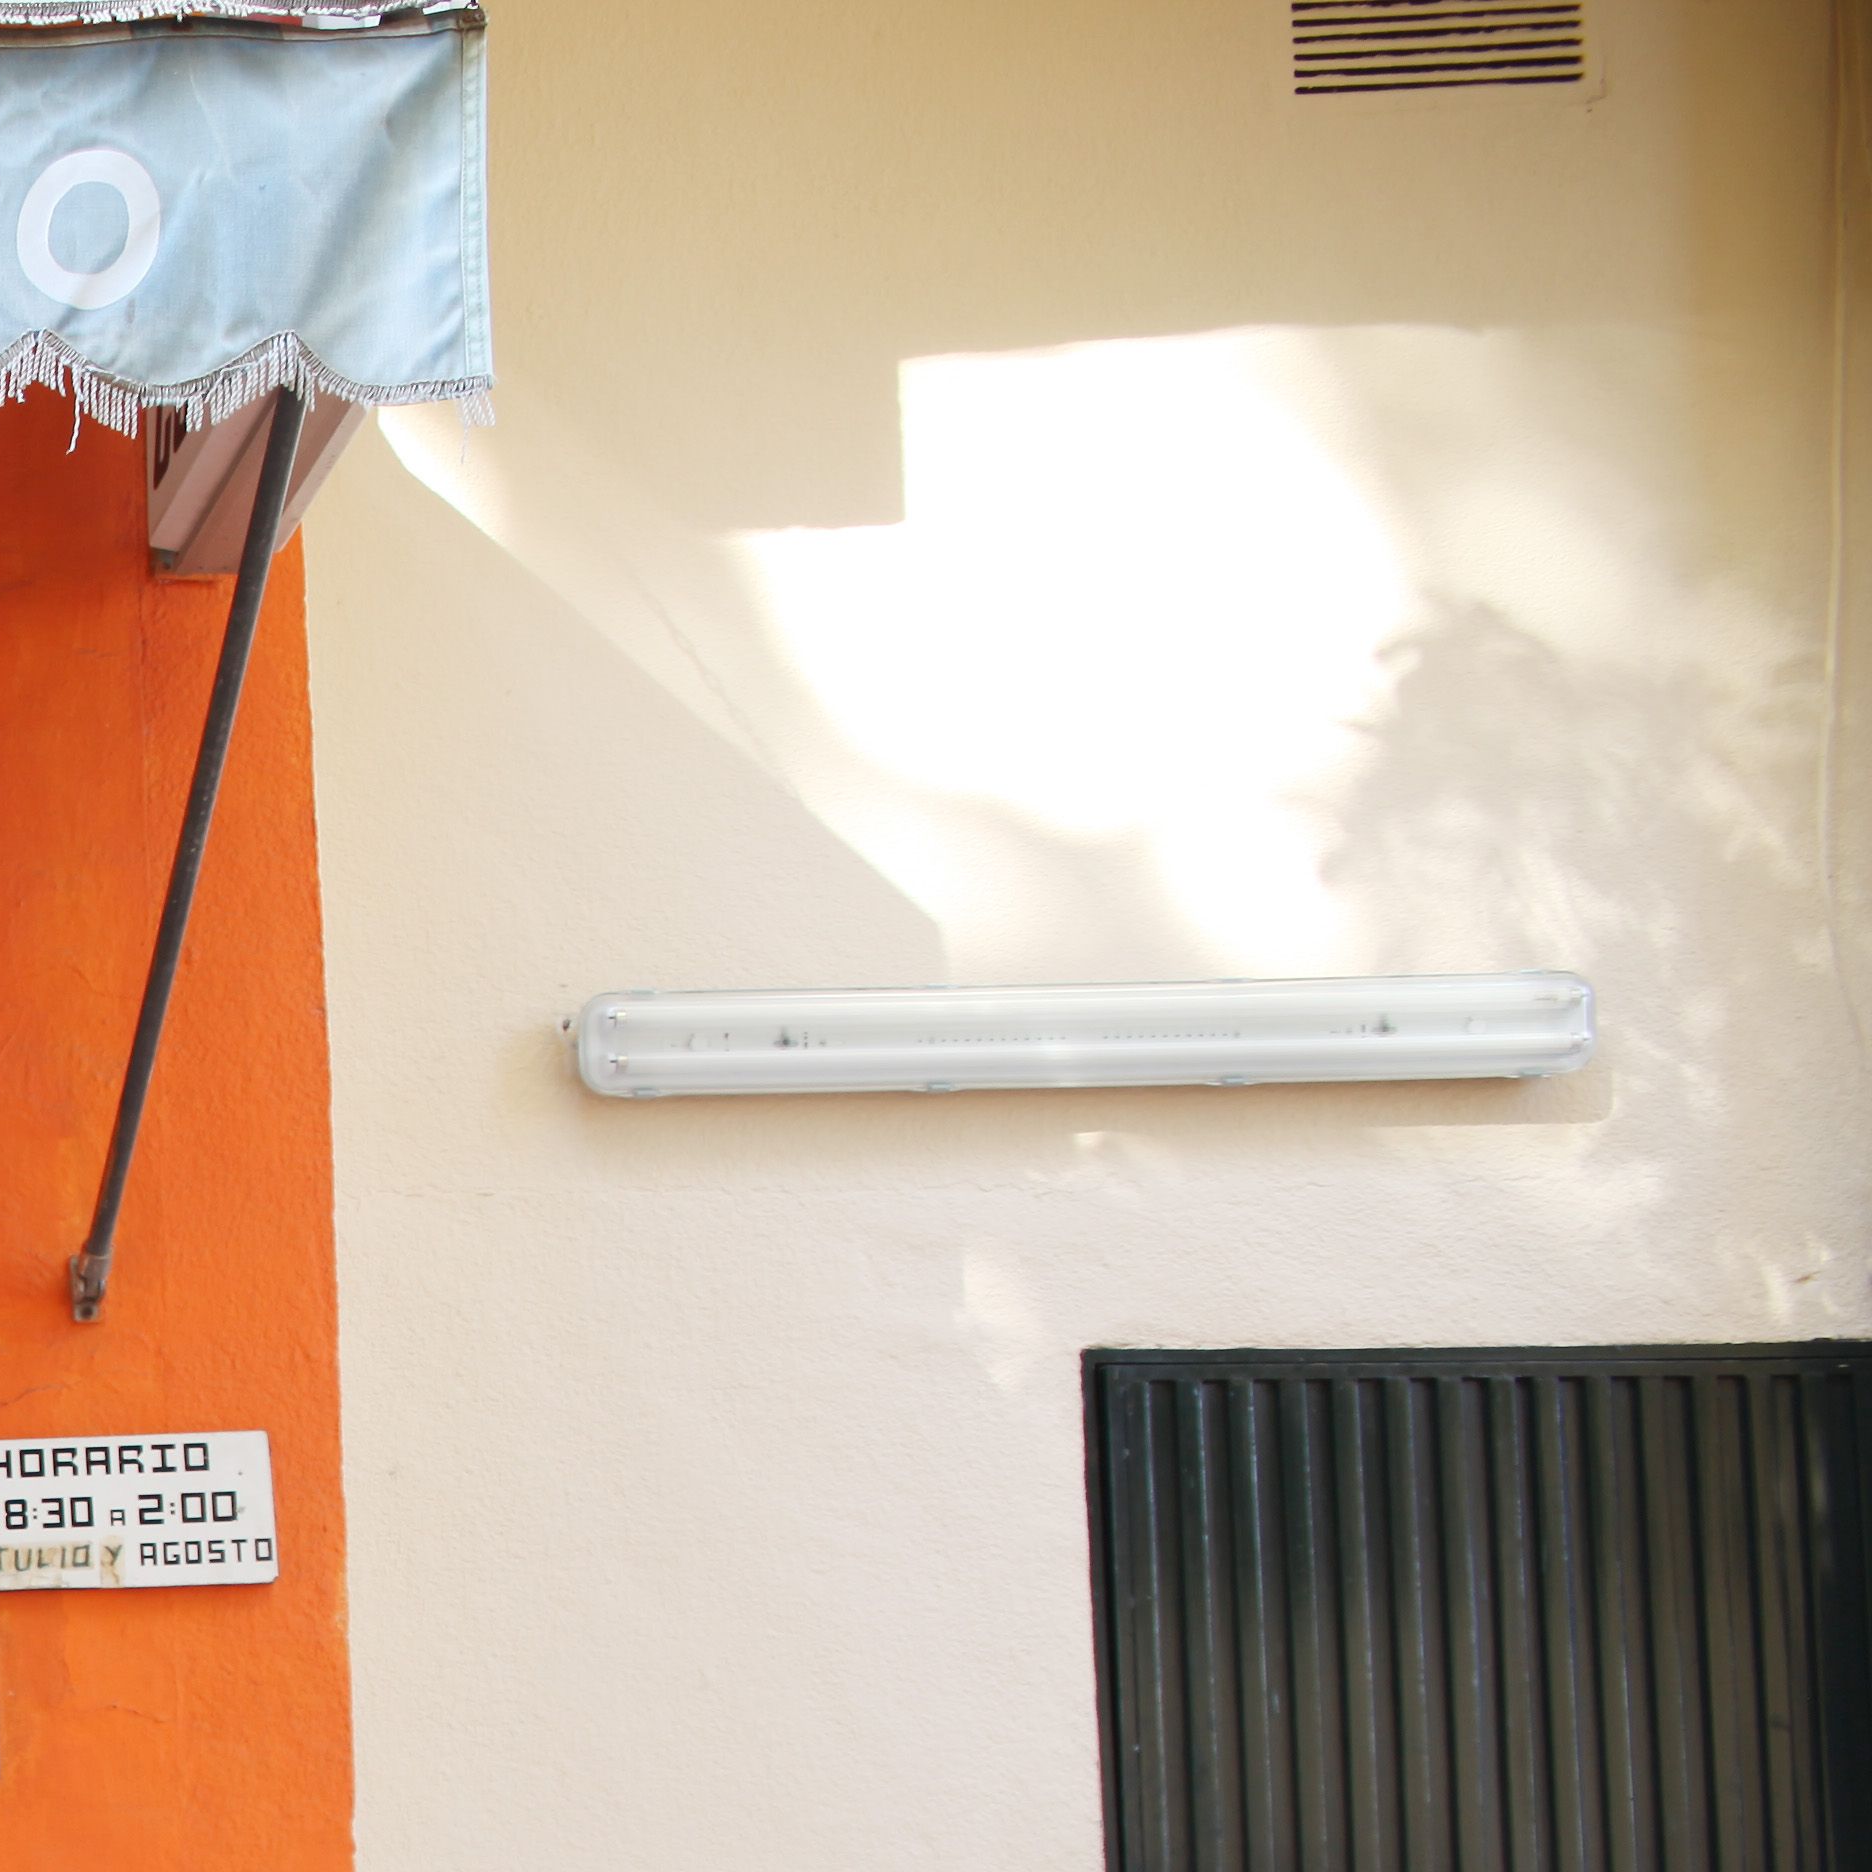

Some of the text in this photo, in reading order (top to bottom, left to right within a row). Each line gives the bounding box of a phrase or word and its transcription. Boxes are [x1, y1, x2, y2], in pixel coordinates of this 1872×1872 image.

[4, 1496, 94, 1530] 8:30
[110, 1508, 127, 1526] A
[138, 1491, 238, 1526] 2:00
[104, 1544, 122, 1566] Y
[140, 1538, 273, 1566] AGOSTO
